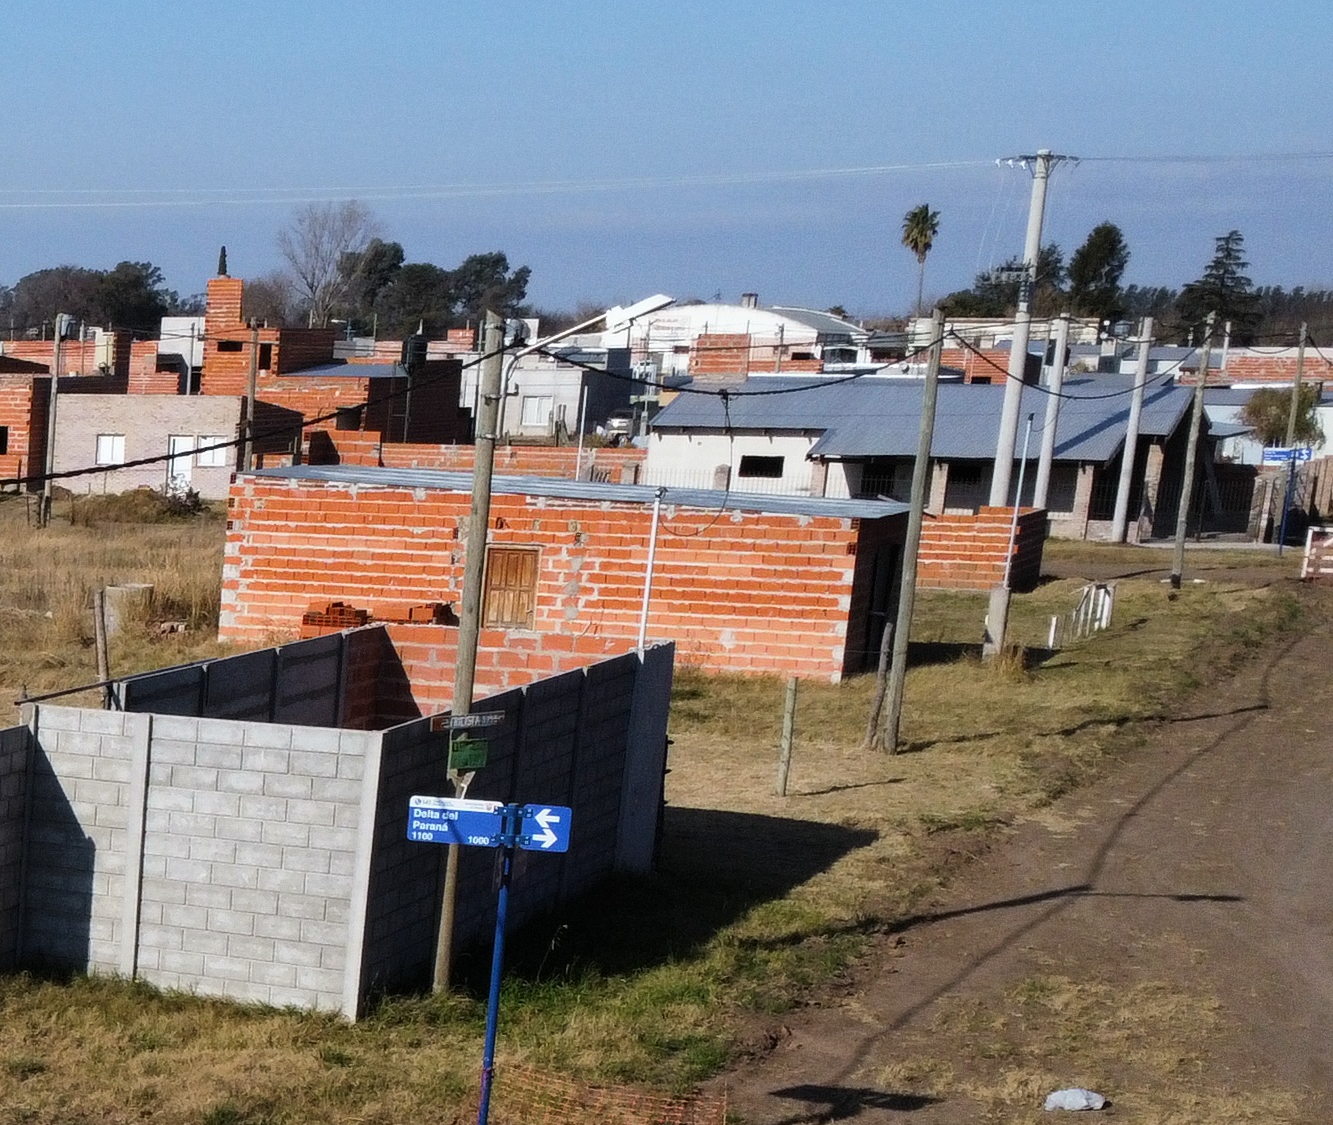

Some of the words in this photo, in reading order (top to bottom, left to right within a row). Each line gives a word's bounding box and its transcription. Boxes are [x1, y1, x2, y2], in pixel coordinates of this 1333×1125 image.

[413, 808, 439, 819] Delta
[441, 810, 458, 820] del
[413, 820, 448, 831] Paraná
[412, 831, 433, 840] 1100
[467, 836, 489, 845] 1000
